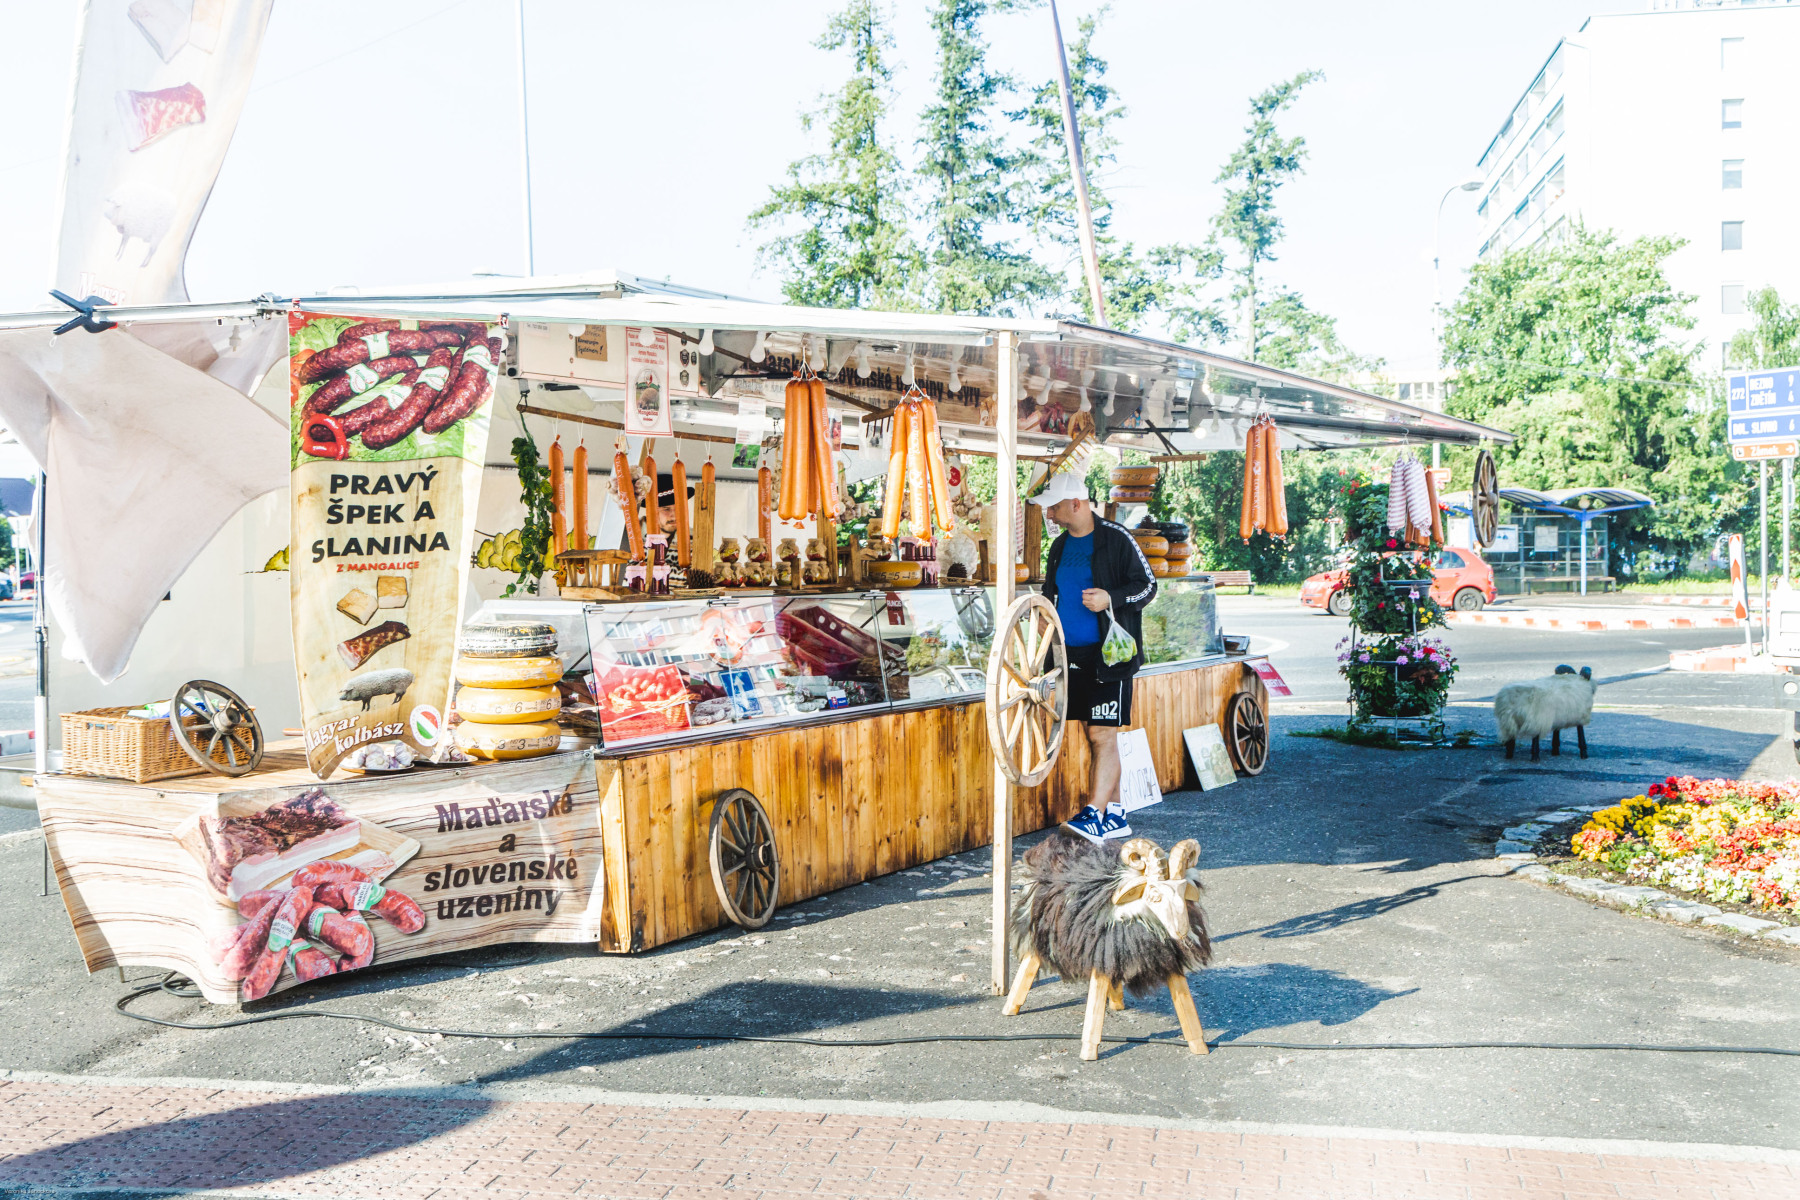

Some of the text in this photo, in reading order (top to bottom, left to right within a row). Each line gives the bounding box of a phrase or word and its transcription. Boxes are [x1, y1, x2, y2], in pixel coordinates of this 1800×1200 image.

[1788, 374, 1795, 387] 9
[1731, 388, 1745, 401] 272
[1787, 390, 1795, 403] 4
[1751, 420, 1778, 434] SLIVNO
[1788, 418, 1795, 432] 6
[1749, 445, 1779, 456] Zámek
[330, 464, 439, 495] PRAVÝ
[326, 498, 436, 525] ŠPEK A
[311, 531, 450, 563] SLANINA
[336, 560, 420, 573] Z MANGALICE
[515, 702, 523, 713] 6
[1091, 700, 1119, 716] 1902
[334, 721, 405, 756] kolbász
[517, 738, 526, 750] 3
[434, 784, 573, 833] Maďarské
[498, 833, 516, 853] a
[423, 849, 578, 892] slovenské
[436, 885, 564, 920] uzeniny
